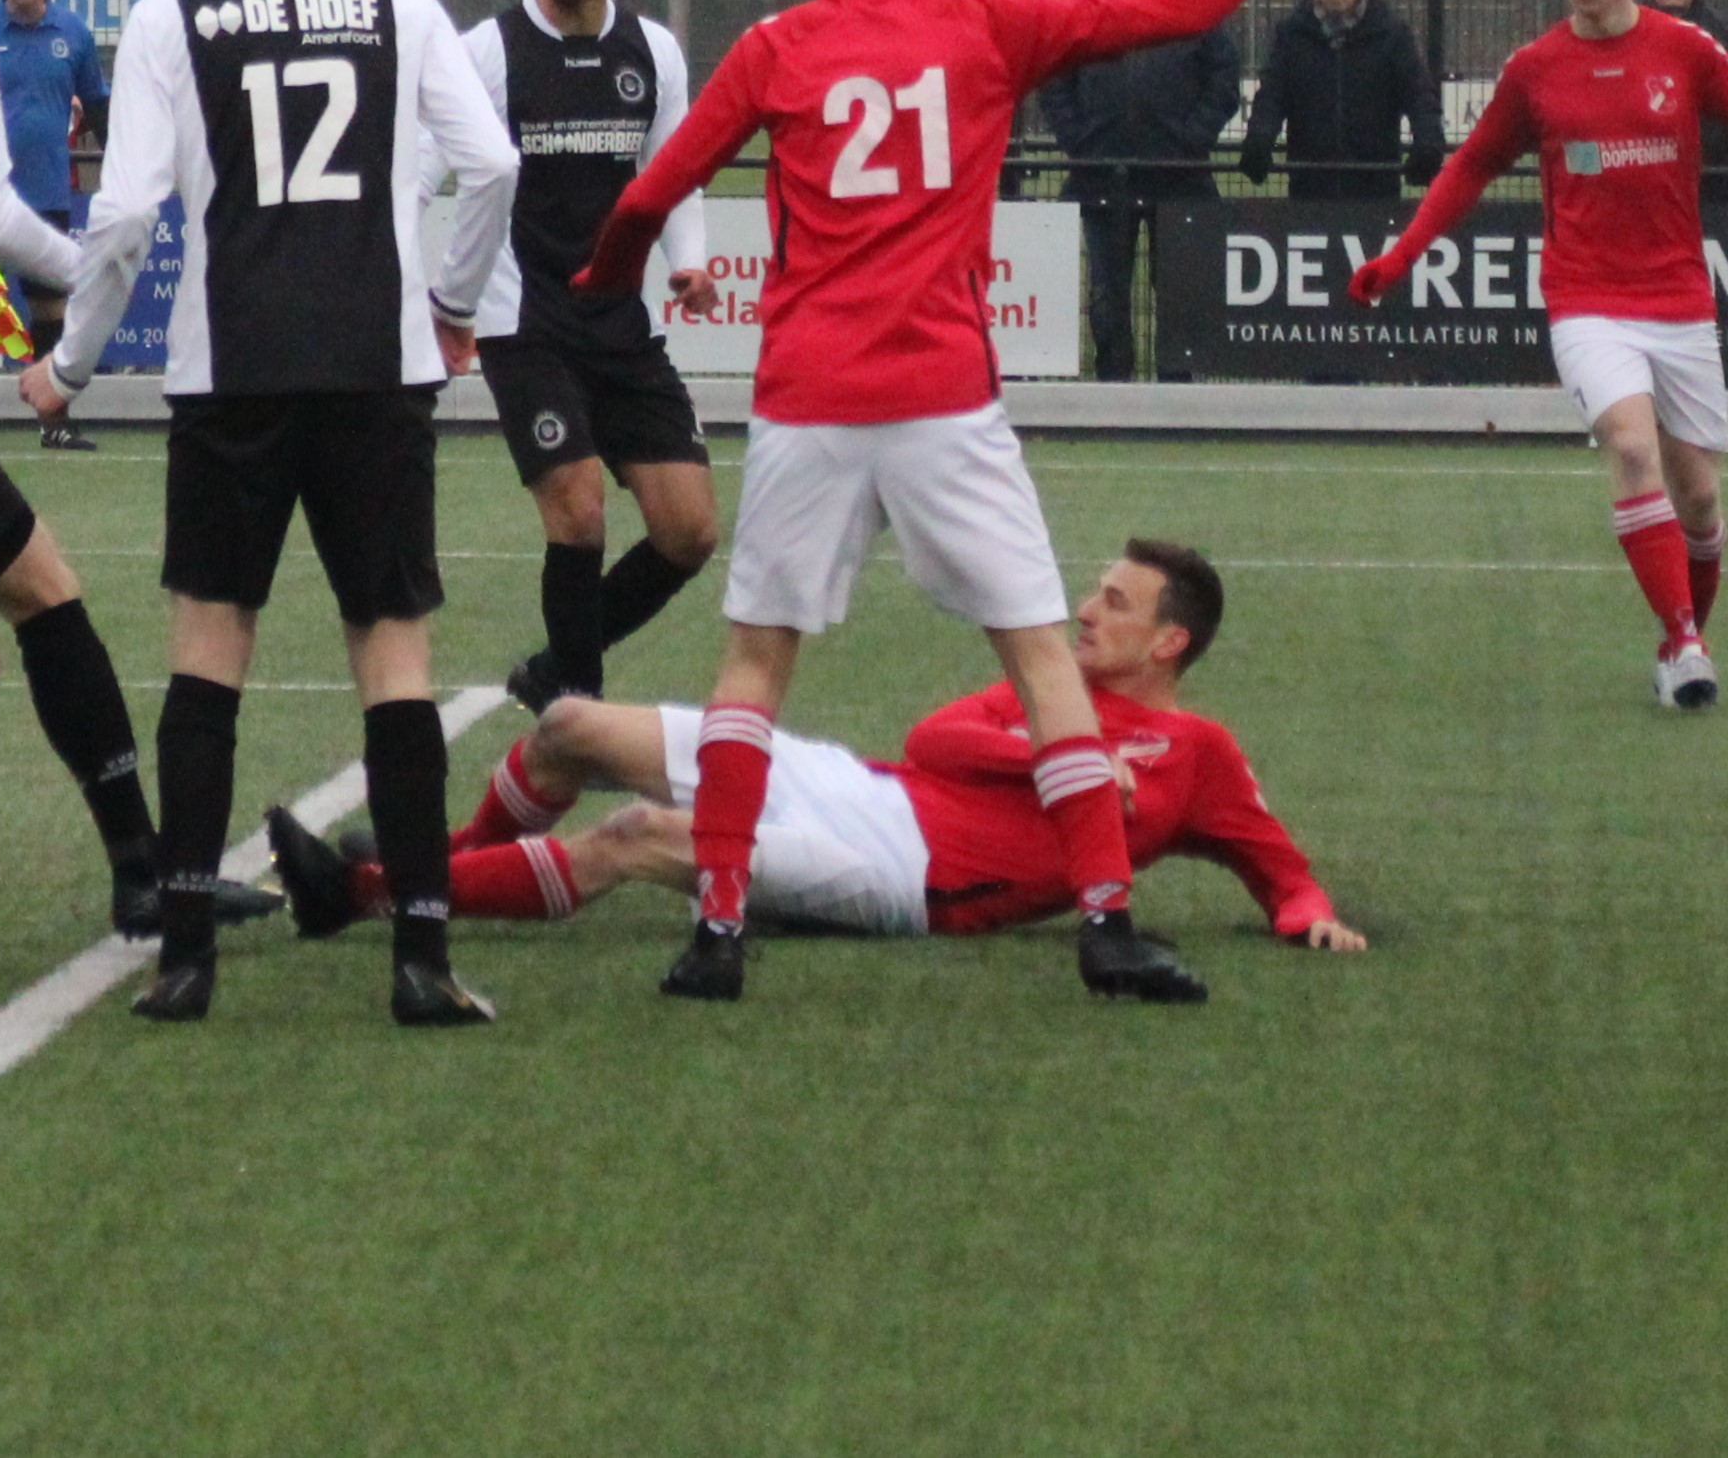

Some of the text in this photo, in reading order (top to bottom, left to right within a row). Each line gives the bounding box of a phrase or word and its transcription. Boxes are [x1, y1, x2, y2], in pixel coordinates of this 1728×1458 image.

[301, 30, 382, 46] Amersfoort
[240, 57, 362, 208] 12
[823, 66, 953, 199] 21
[115, 327, 138, 344] 06
[1226, 324, 1538, 346] TOTAALINSTALLATEUR IN
